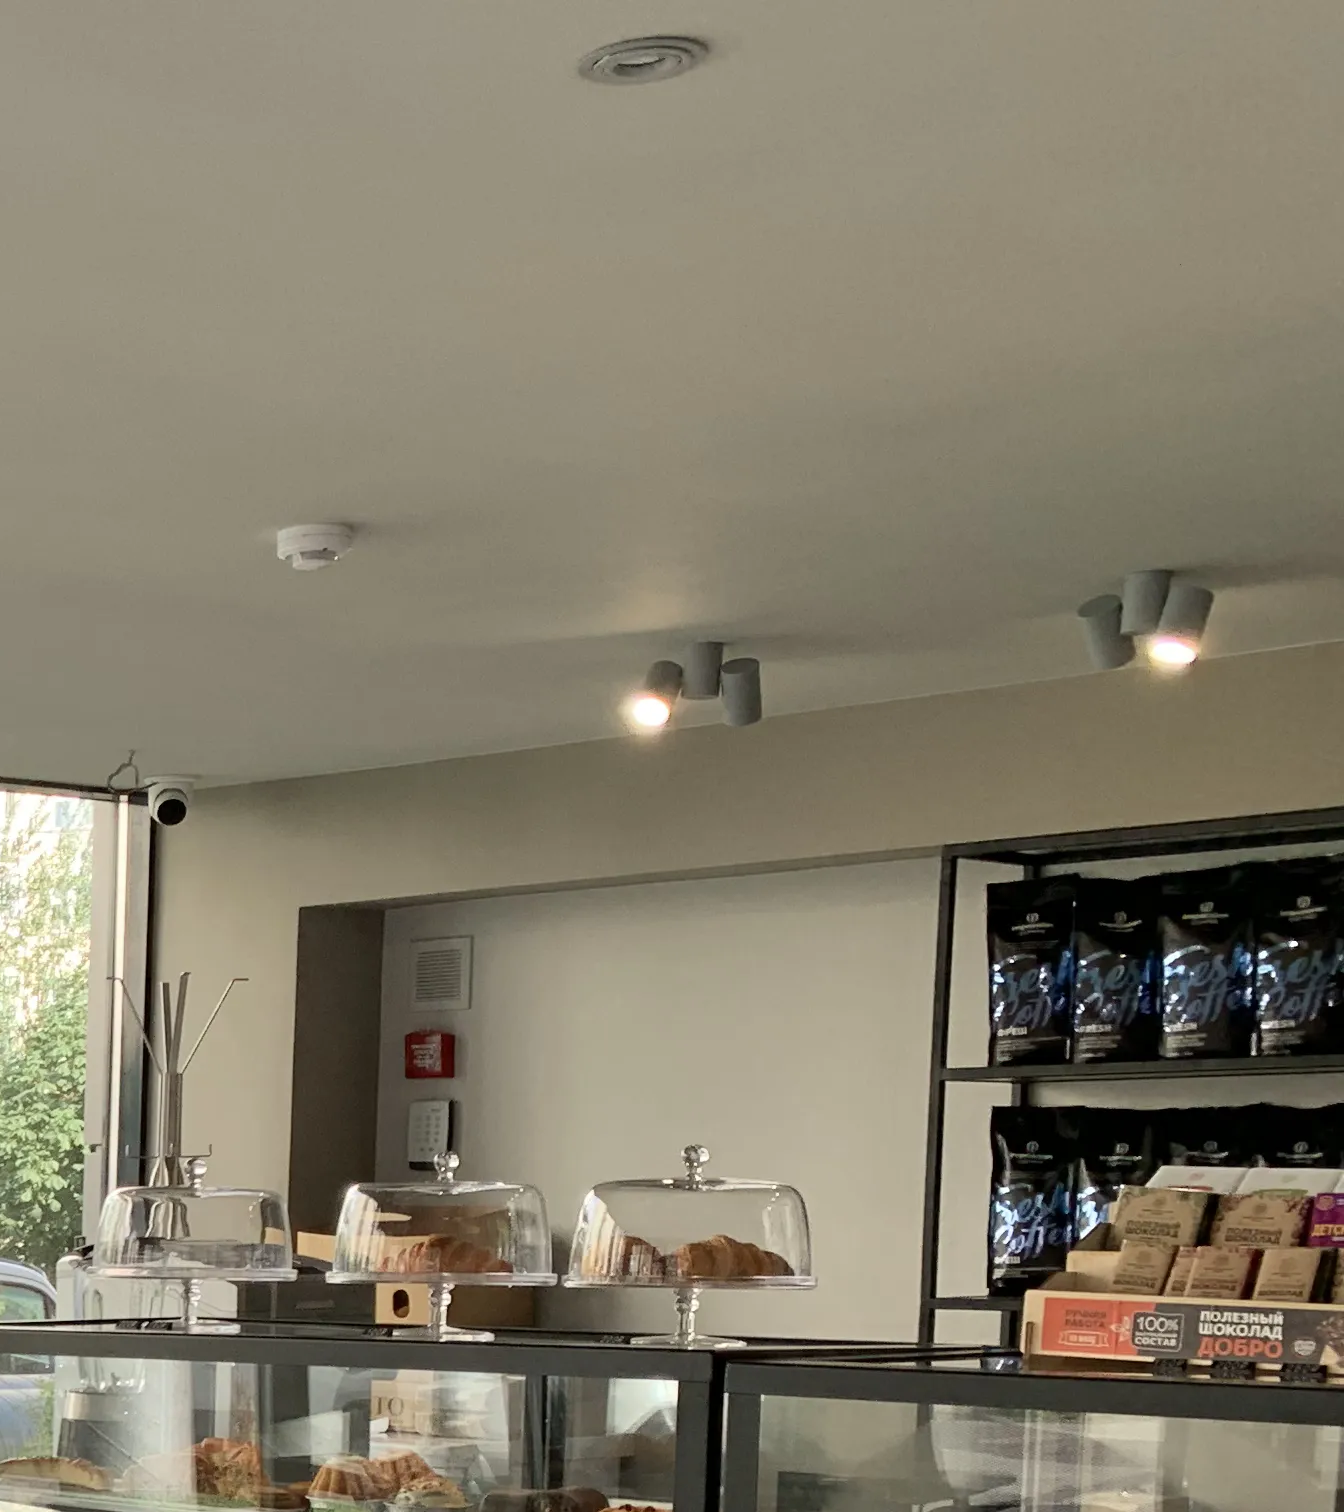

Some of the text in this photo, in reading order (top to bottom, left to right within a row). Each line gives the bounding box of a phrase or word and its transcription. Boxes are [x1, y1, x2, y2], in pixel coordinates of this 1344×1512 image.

[1065, 1318, 1106, 1328] РАБОТА
[1136, 1316, 1179, 1332] 100%
[1200, 1310, 1284, 1325] ПОЛЕЗНЫЙ
[1199, 1322, 1283, 1340] ШОКОЛАД
[1134, 1336, 1177, 1347] СОСТАВ
[1197, 1336, 1284, 1358] ДОБРО
